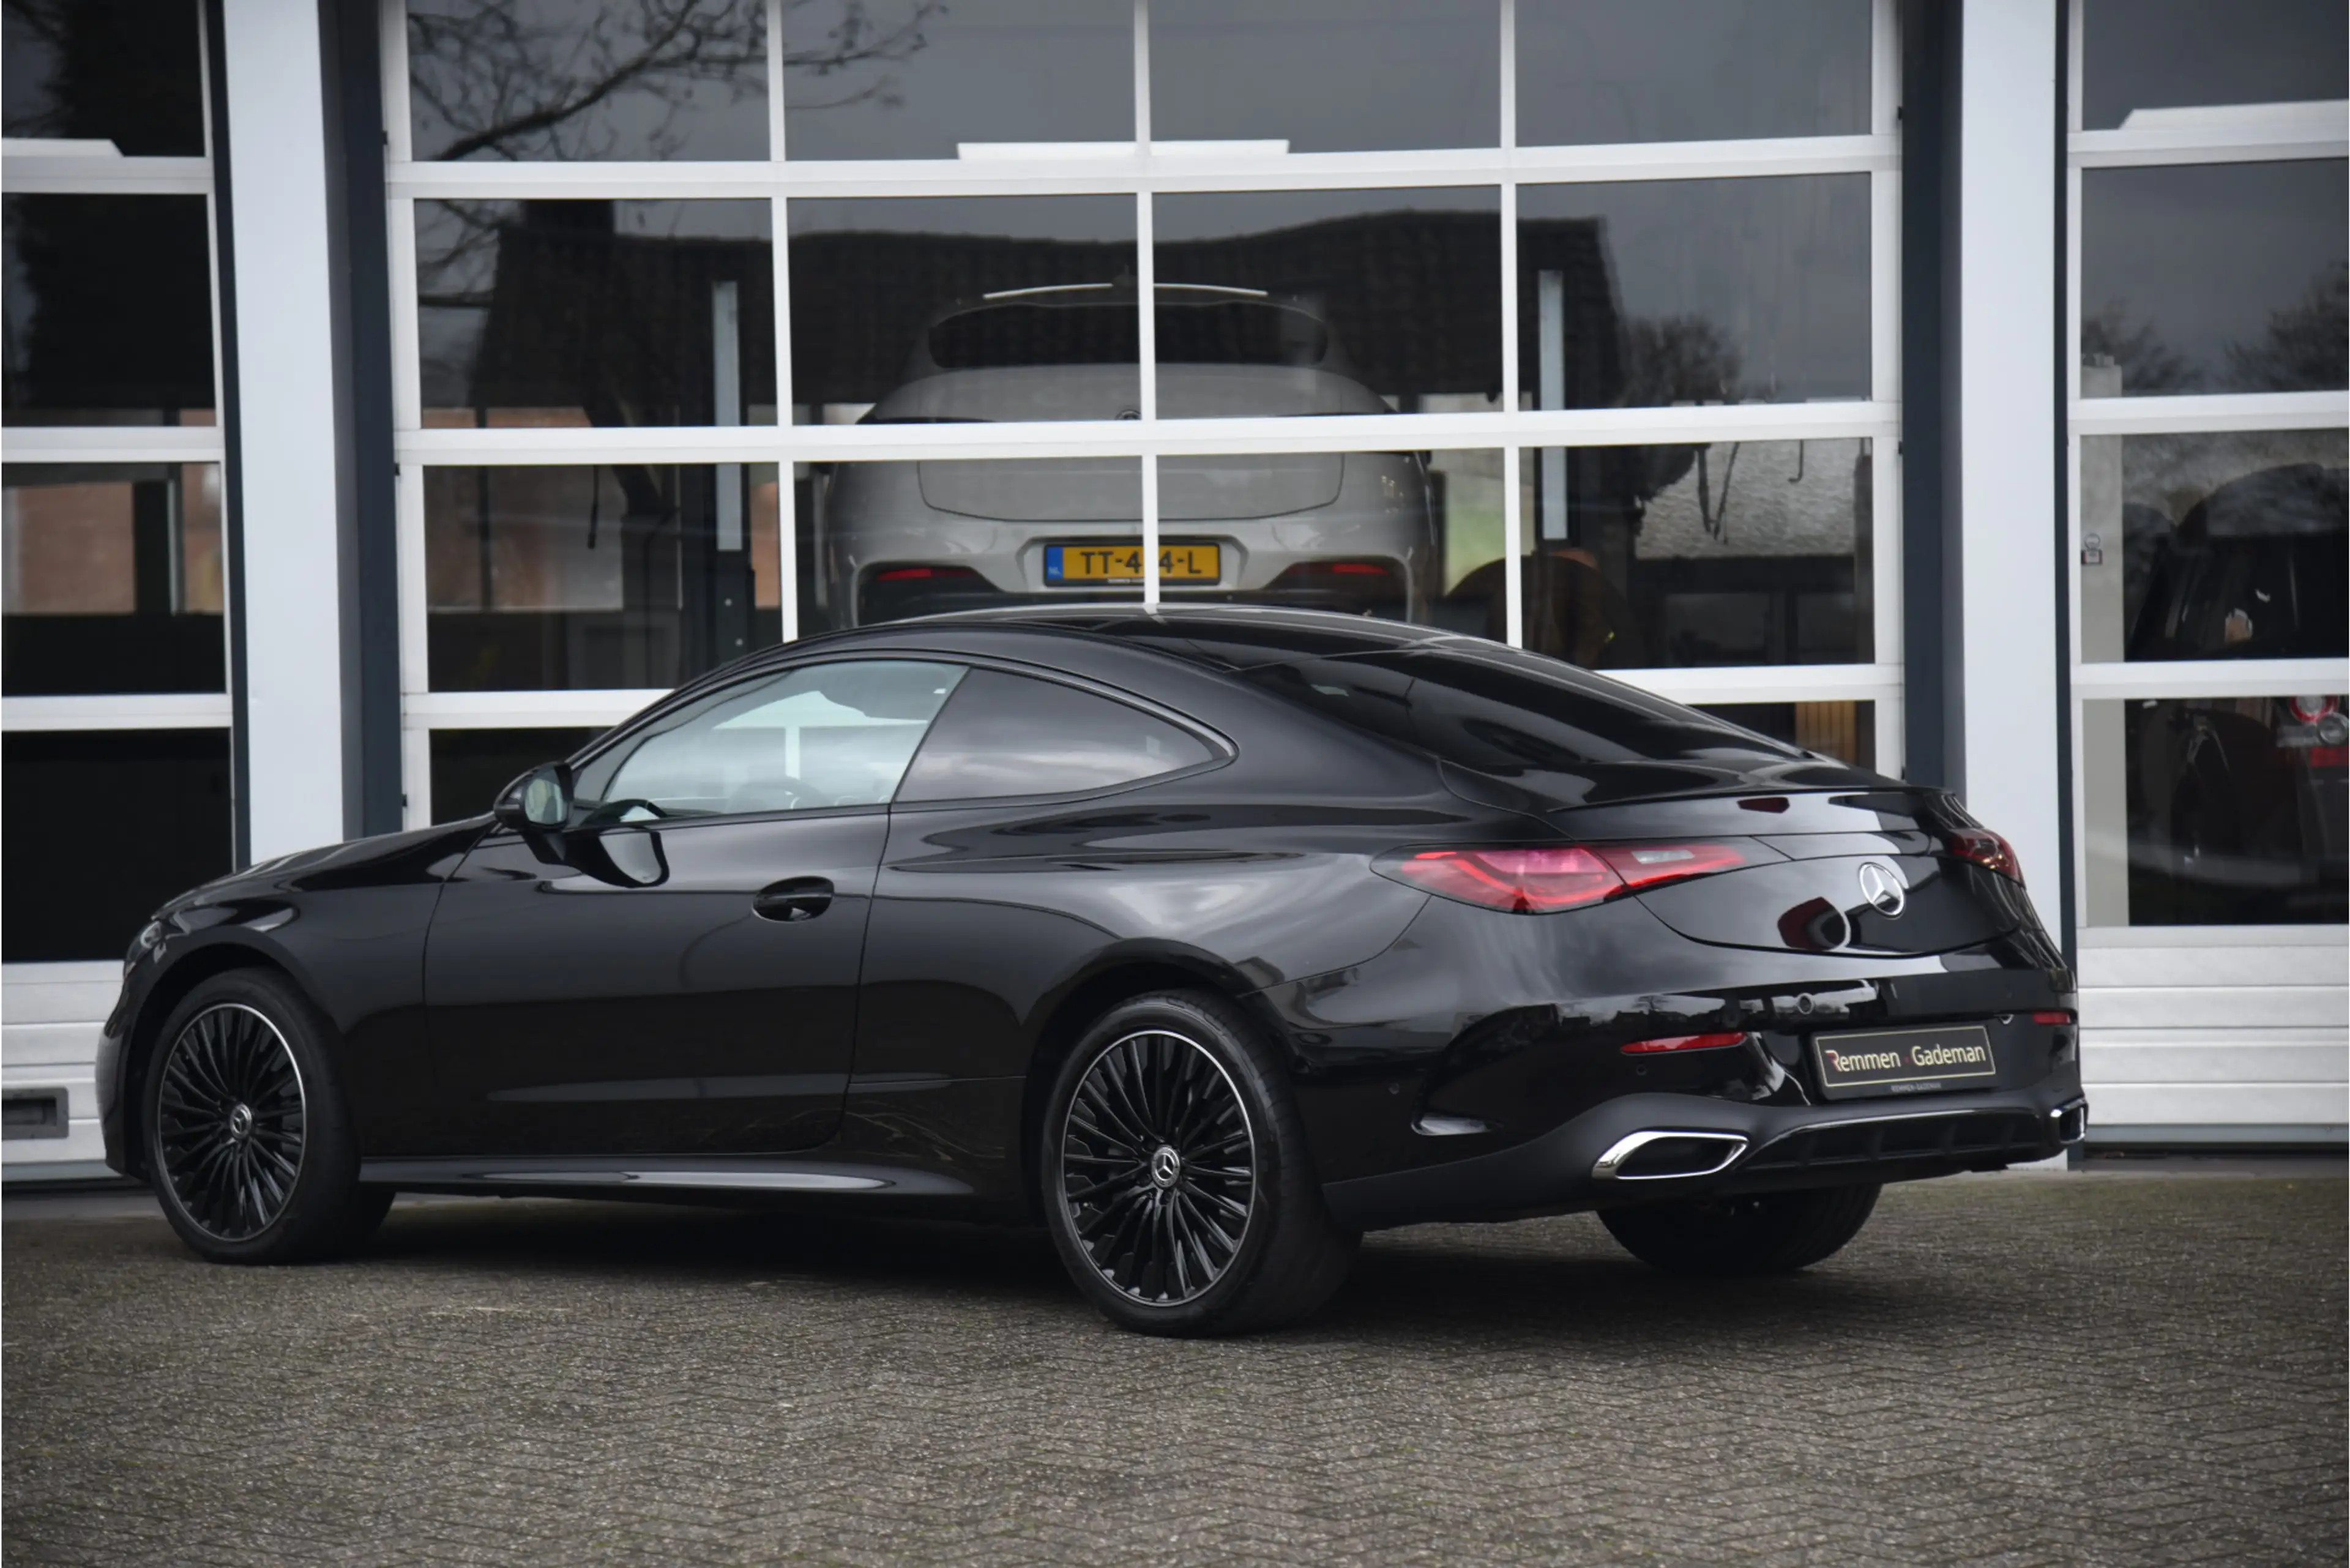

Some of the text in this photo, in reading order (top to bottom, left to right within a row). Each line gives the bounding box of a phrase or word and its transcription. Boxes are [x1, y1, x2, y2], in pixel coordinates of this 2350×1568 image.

[1080, 550, 1202, 574] TT-44-L
[1825, 1043, 1986, 1072] Remmen Gademan
